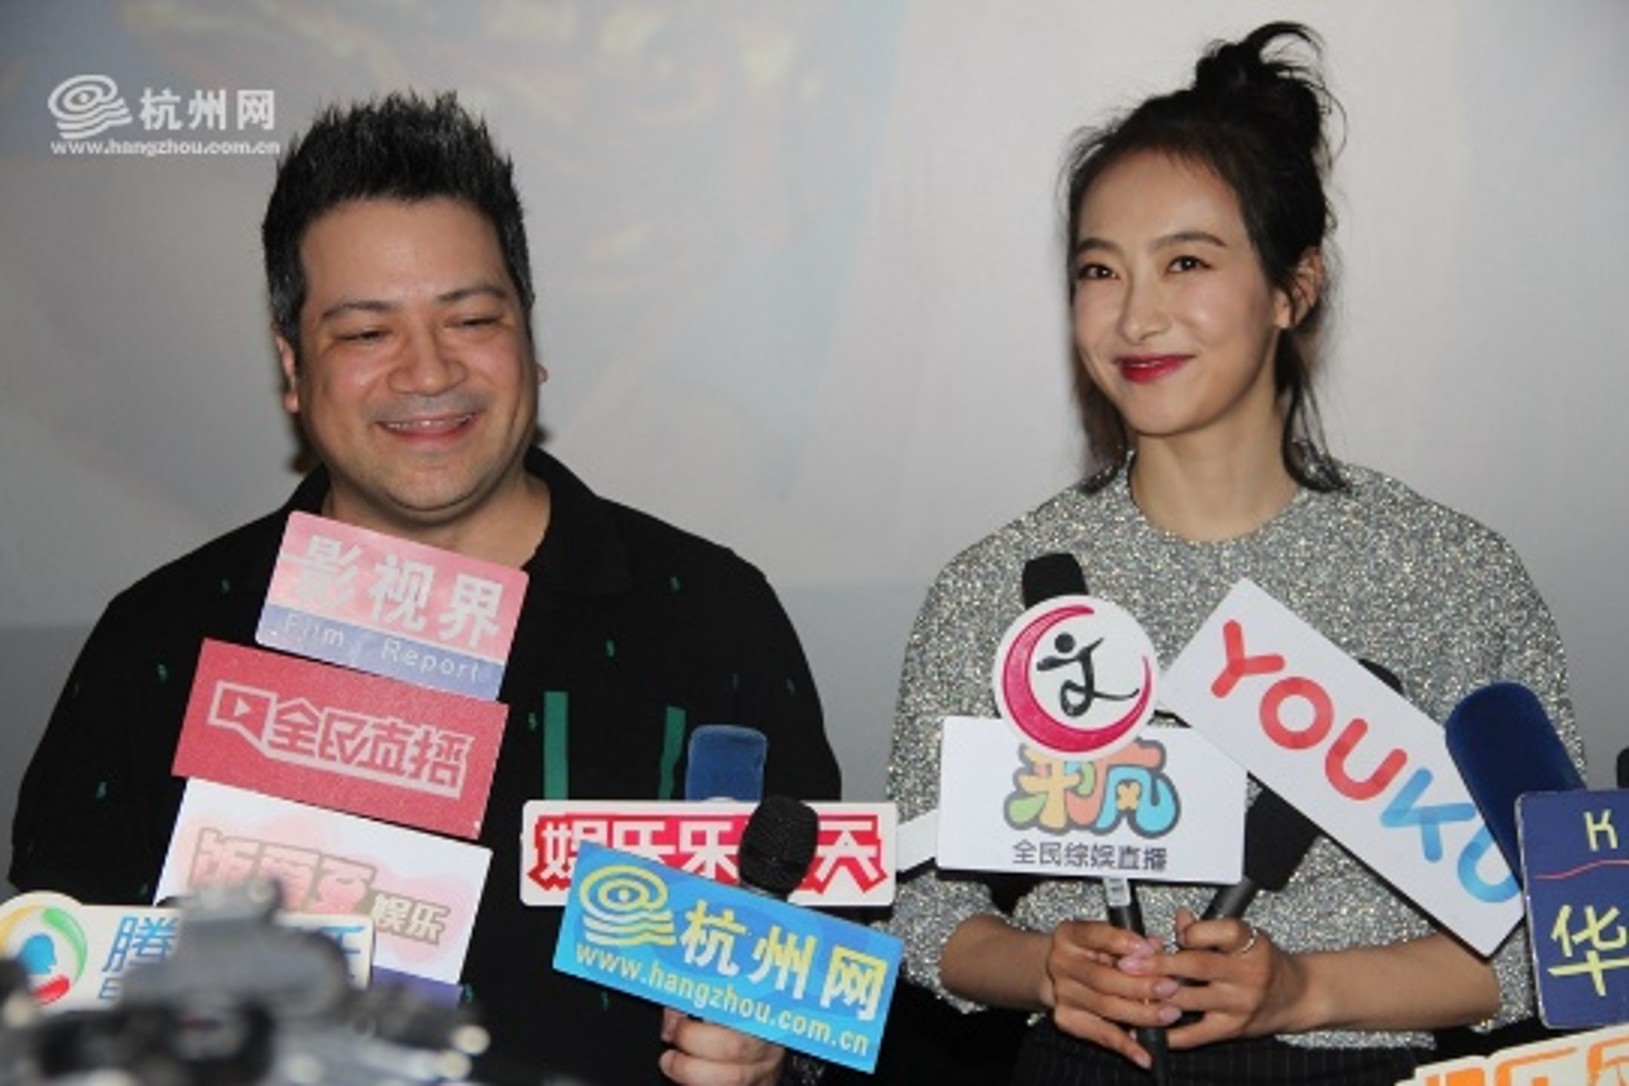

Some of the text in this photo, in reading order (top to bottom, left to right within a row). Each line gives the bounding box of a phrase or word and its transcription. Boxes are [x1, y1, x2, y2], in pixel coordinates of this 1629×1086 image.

[278, 534, 504, 648] 影视界
[284, 612, 479, 683] Film Report
[265, 697, 474, 797] 全民直播
[535, 815, 887, 890] 娱乐乐天
[1012, 839, 1168, 872] 全民综娱直播
[575, 942, 869, 1055] www.hangzhou.com.cn
[680, 901, 889, 1022] 杭州网
